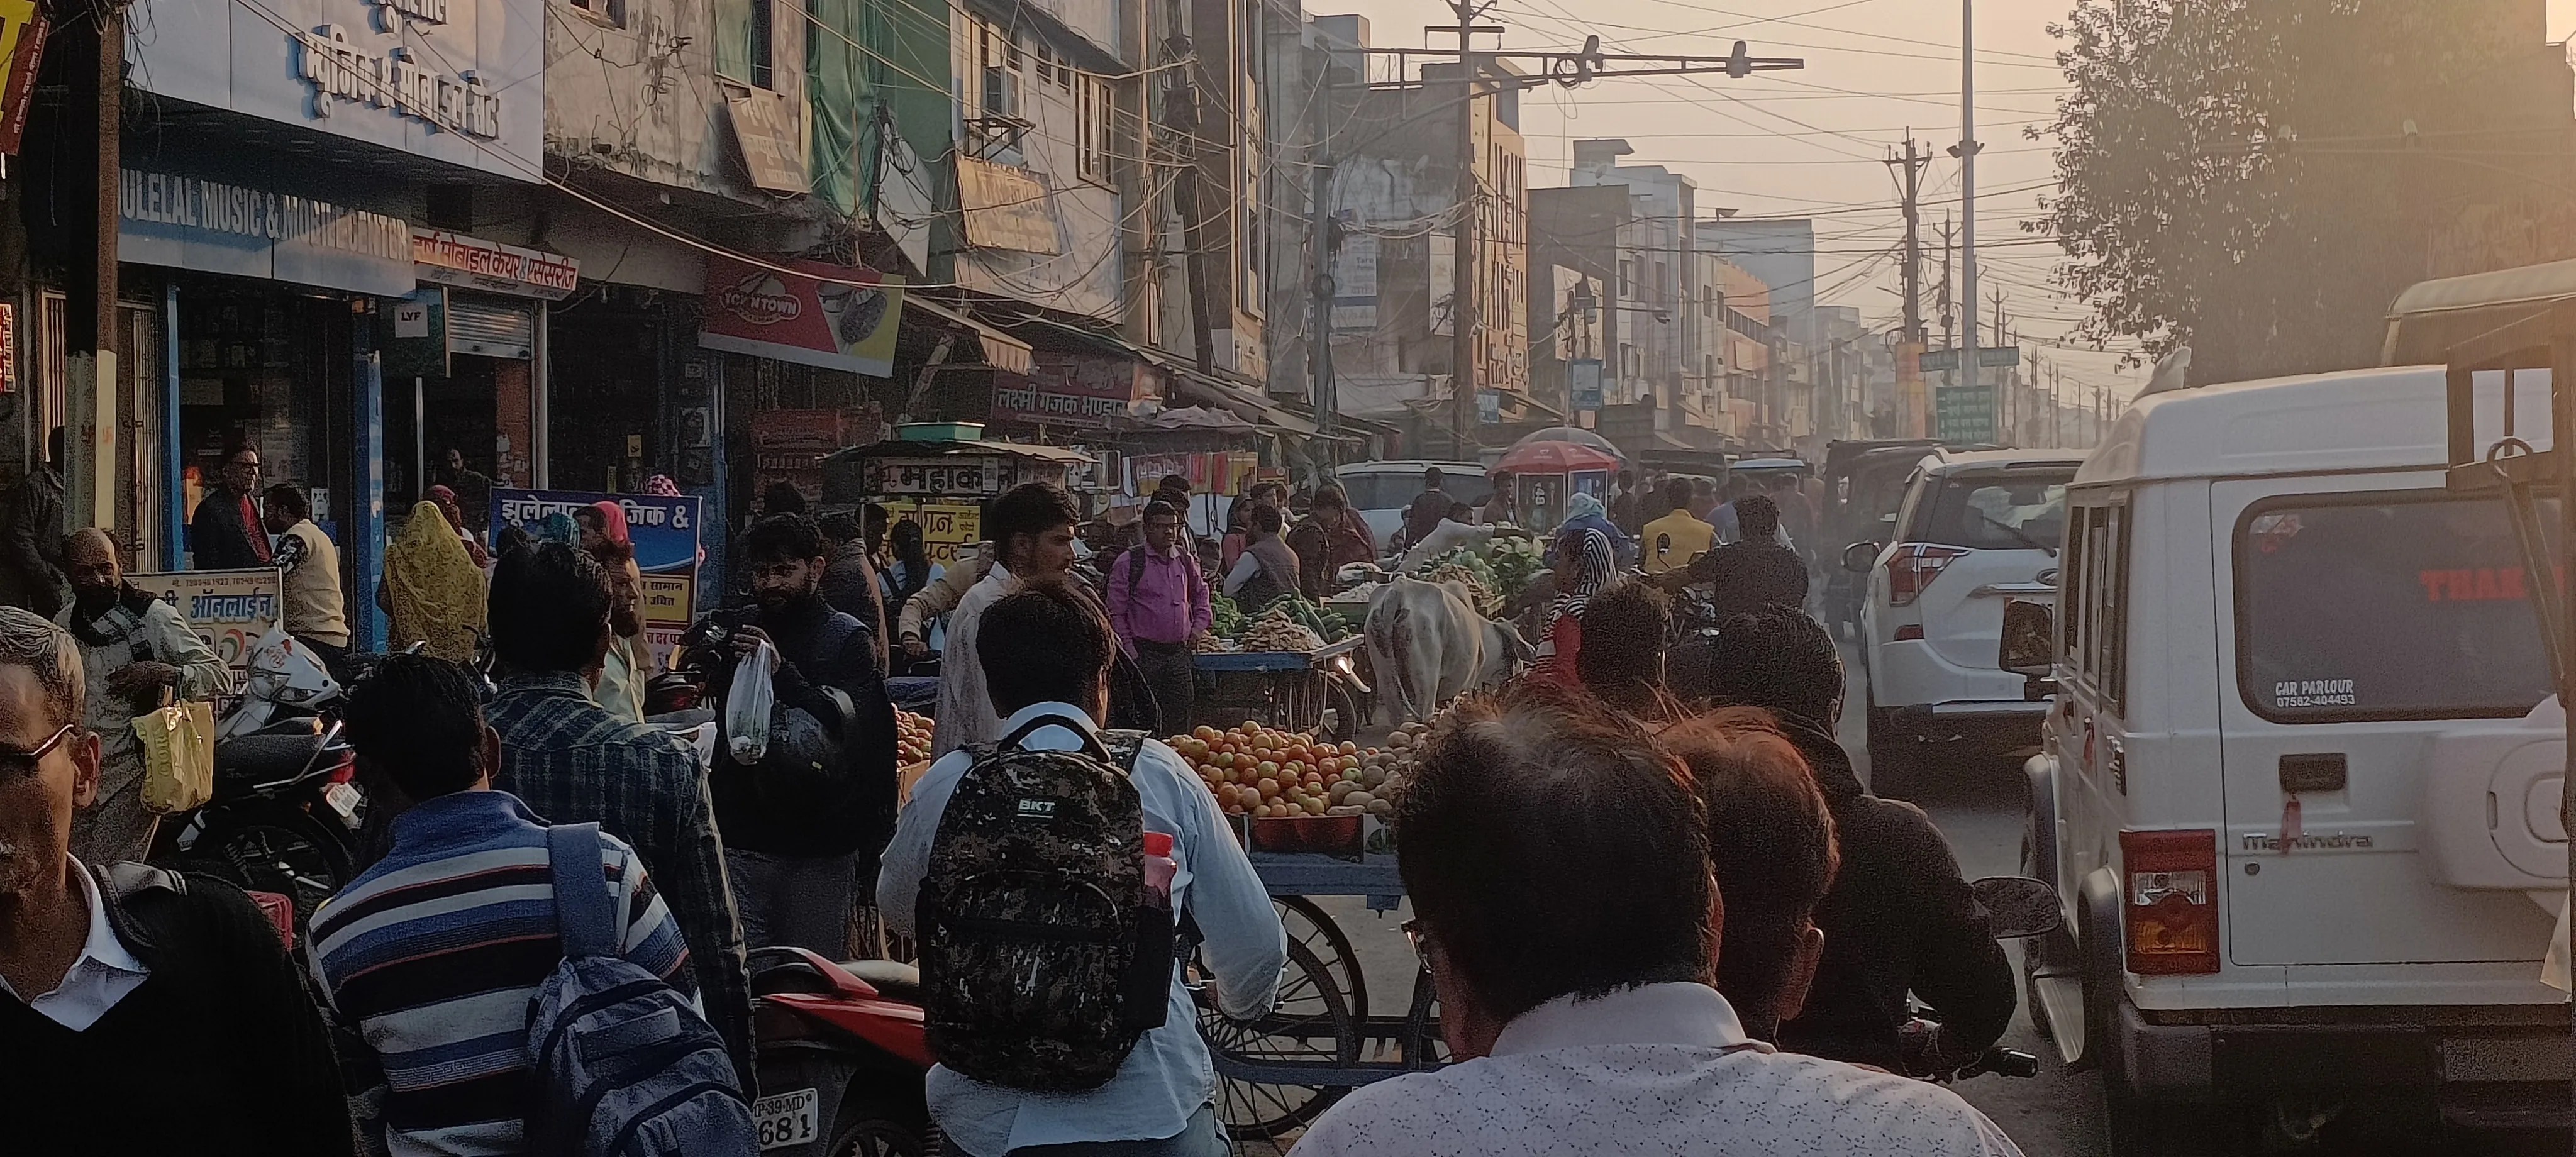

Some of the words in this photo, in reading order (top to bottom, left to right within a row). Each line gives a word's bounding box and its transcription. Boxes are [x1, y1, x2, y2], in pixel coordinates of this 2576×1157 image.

[380, 56, 396, 108] &
[118, 167, 196, 227] ULELAL
[201, 180, 262, 238] MUSIC
[265, 191, 279, 240] &
[281, 194, 347, 248] MOBILE
[348, 208, 408, 261] CENTER
[492, 241, 522, 279] केयर
[761, 298, 797, 315] TOWN
[401, 311, 421, 321] LYF
[997, 383, 1037, 412] लक्ष्मी
[1040, 391, 1080, 416] गजक
[619, 499, 667, 526] जिक
[672, 505, 689, 528] &
[650, 581, 682, 592] सामान
[2275, 682, 2297, 696] CAR
[2302, 679, 2353, 695] PARLOUR
[2277, 694, 2355, 707] 07582-404493
[1018, 799, 1055, 812] BKT
